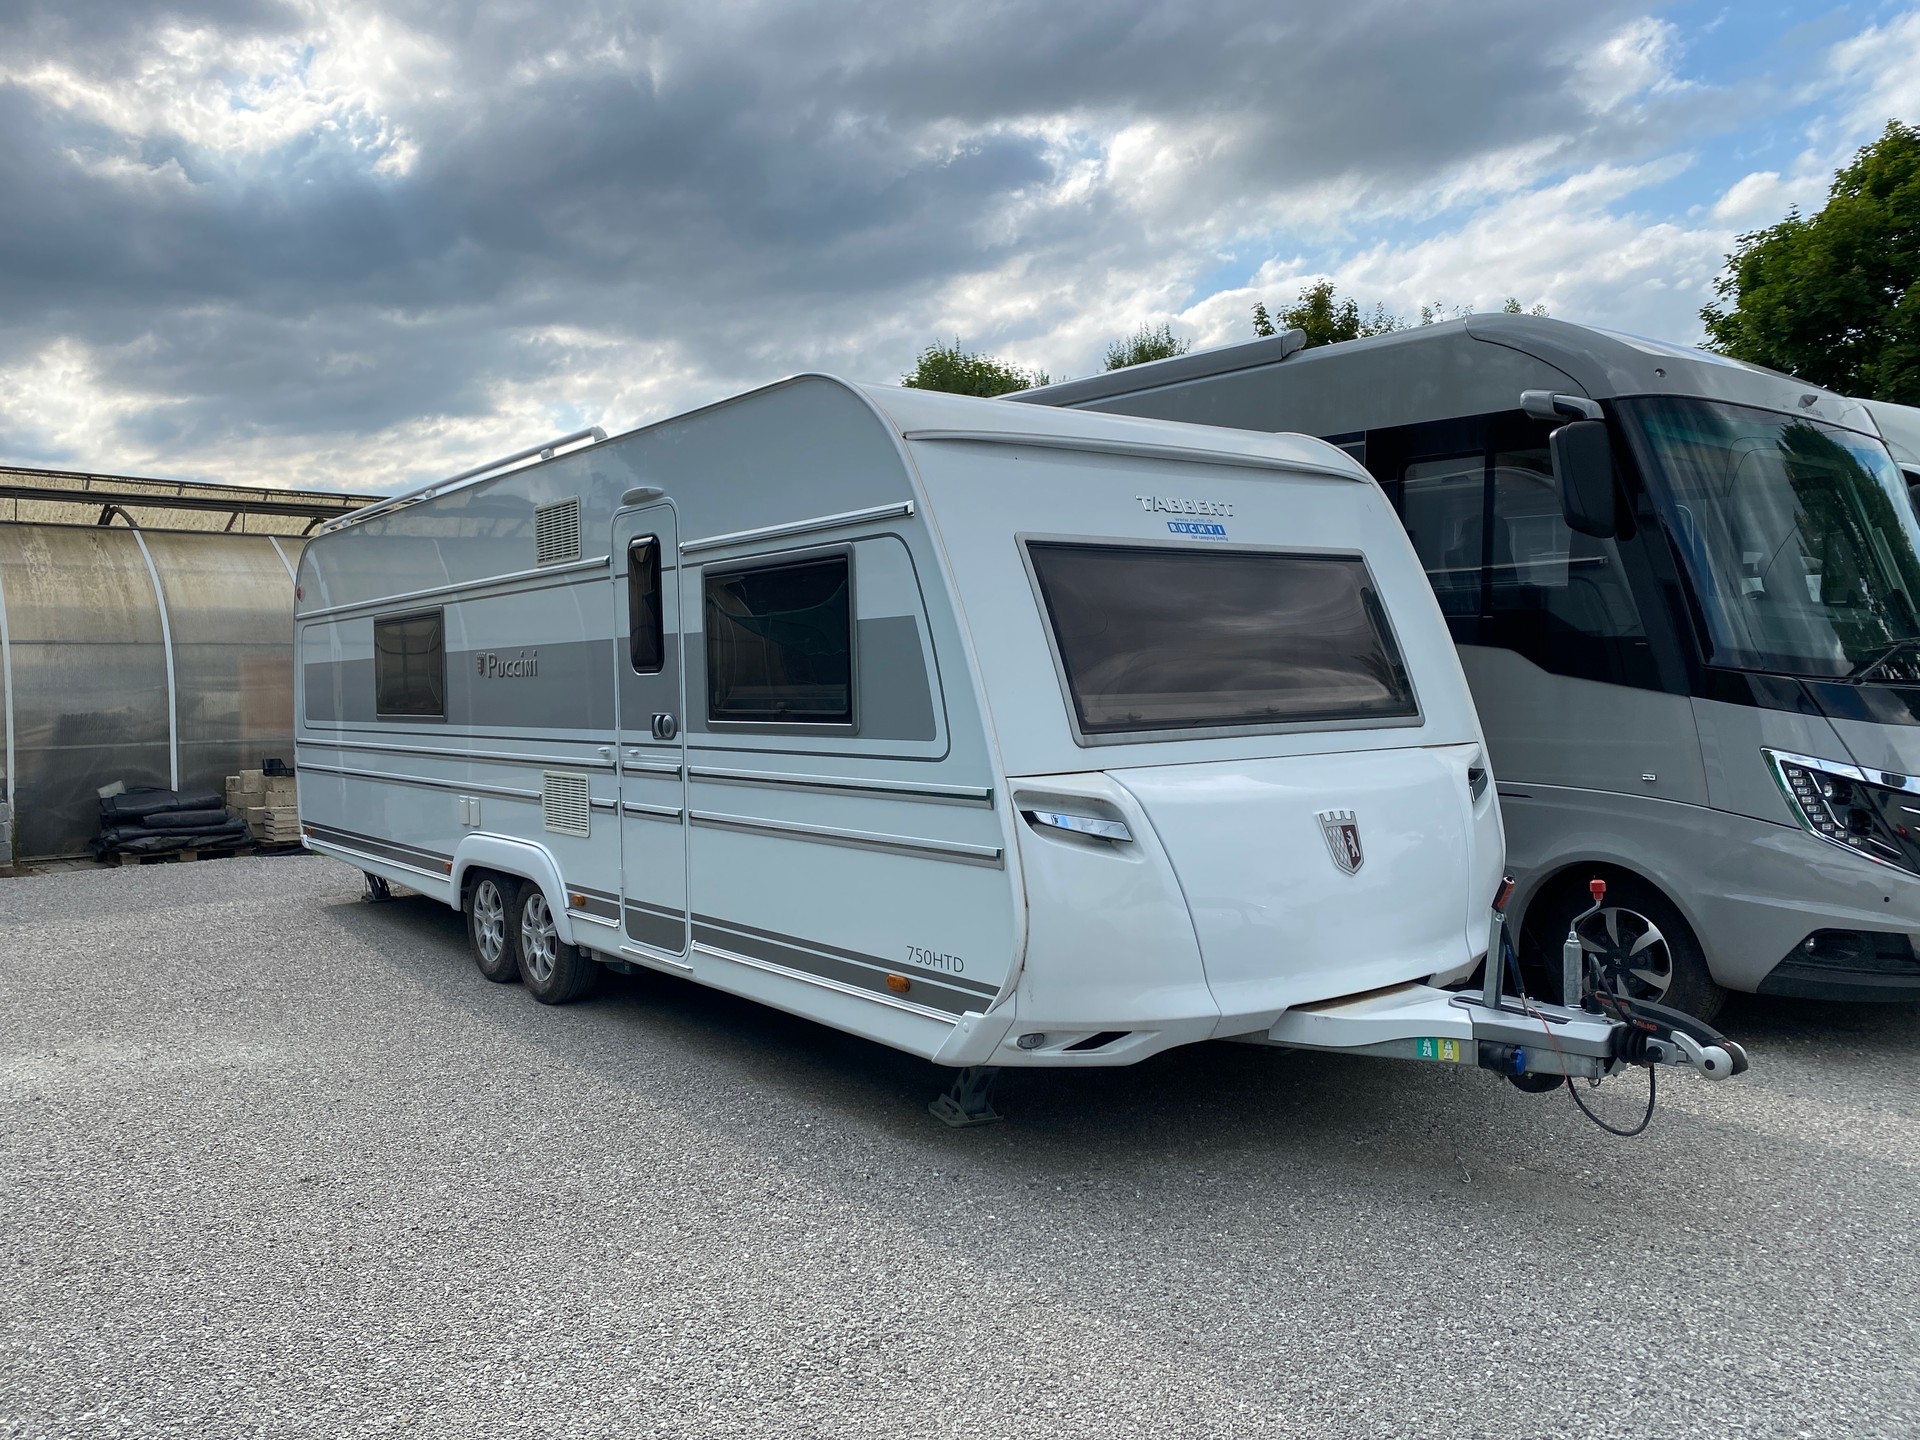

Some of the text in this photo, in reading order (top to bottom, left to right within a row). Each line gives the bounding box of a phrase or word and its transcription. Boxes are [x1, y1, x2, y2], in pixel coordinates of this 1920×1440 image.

[1135, 495, 1233, 516] TABBERT
[1168, 523, 1224, 535] RUCHTI
[486, 650, 538, 678] Puccini
[906, 945, 964, 973] 750HTD
[1422, 1046, 1432, 1057] 24
[1443, 1049, 1454, 1060] 23
